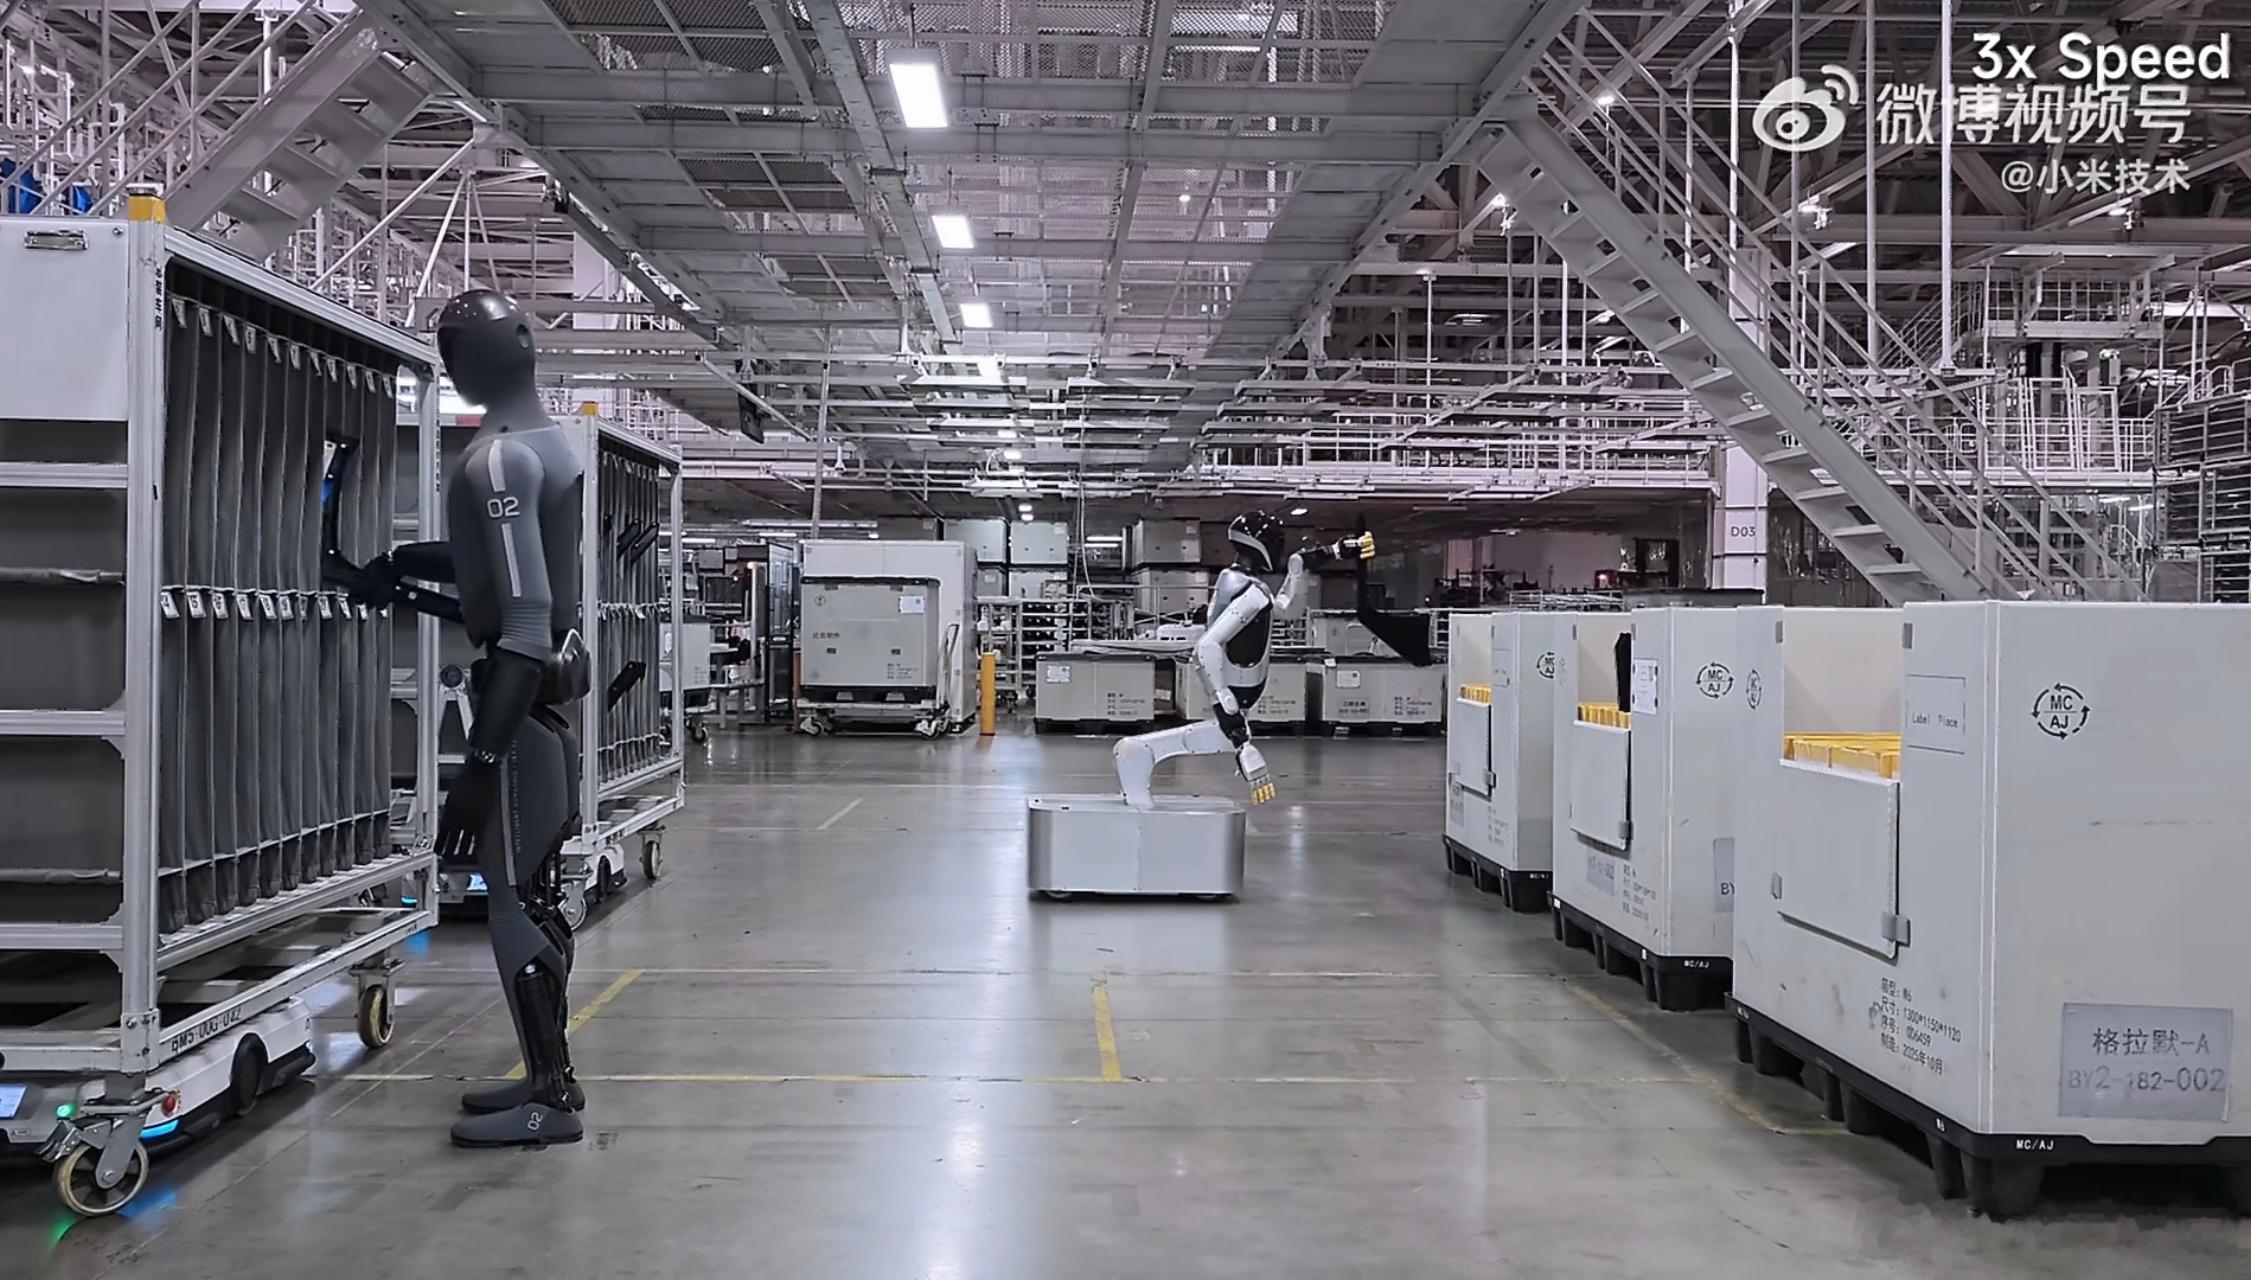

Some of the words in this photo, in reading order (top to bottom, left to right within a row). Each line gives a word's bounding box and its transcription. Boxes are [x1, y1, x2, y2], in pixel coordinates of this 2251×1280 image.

[487, 496, 520, 518] 02
[1731, 526, 1756, 537] D03
[2050, 695, 2073, 710] MC
[1912, 713, 1931, 725] Label
[2050, 715, 2069, 729] AJ
[2092, 1027, 2211, 1056] 格拉默-A
[2067, 1065, 2225, 1092] BY2-182-002
[527, 1111, 544, 1131] 02
[2016, 1139, 2054, 1150] MC/AJ
